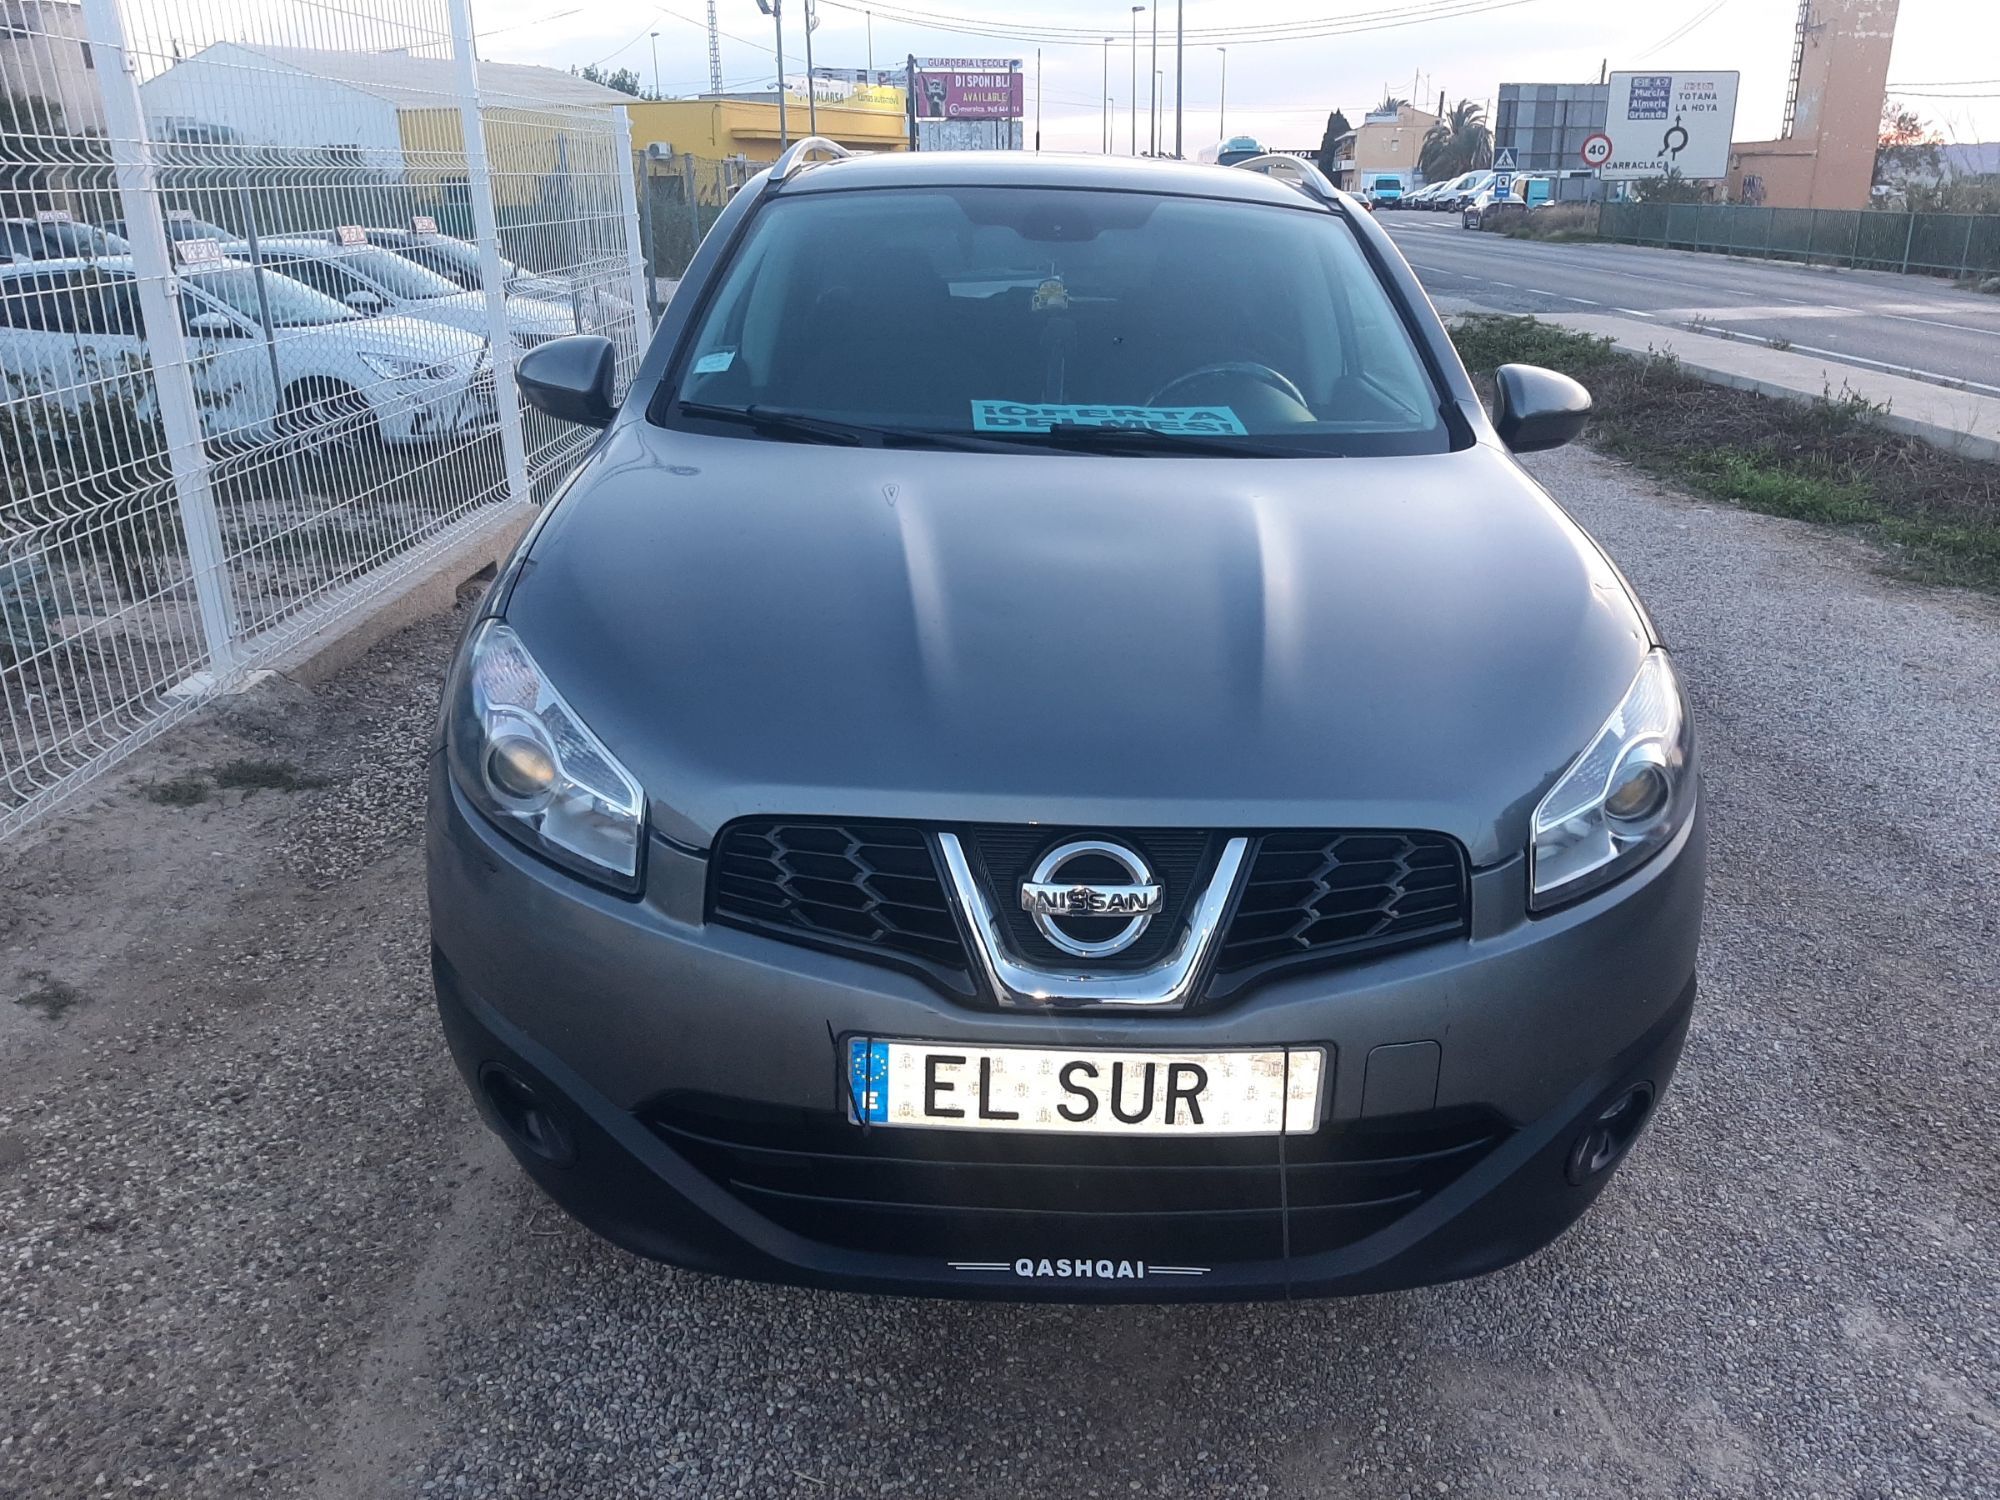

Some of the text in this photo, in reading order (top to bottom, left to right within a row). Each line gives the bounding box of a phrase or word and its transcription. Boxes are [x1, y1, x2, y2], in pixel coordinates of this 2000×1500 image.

[928, 58, 974, 68] GUARDERIA
[1634, 88, 1665, 97] Murcia
[1675, 104, 1718, 112] LA HOYA
[1628, 110, 1667, 119] Granada
[1588, 144, 1606, 155] 40
[1036, 890, 1149, 912] NISSAN
[924, 1054, 1209, 1126] EL SUR
[862, 1091, 879, 1109] E
[1015, 1258, 1144, 1279] QASHQAI
